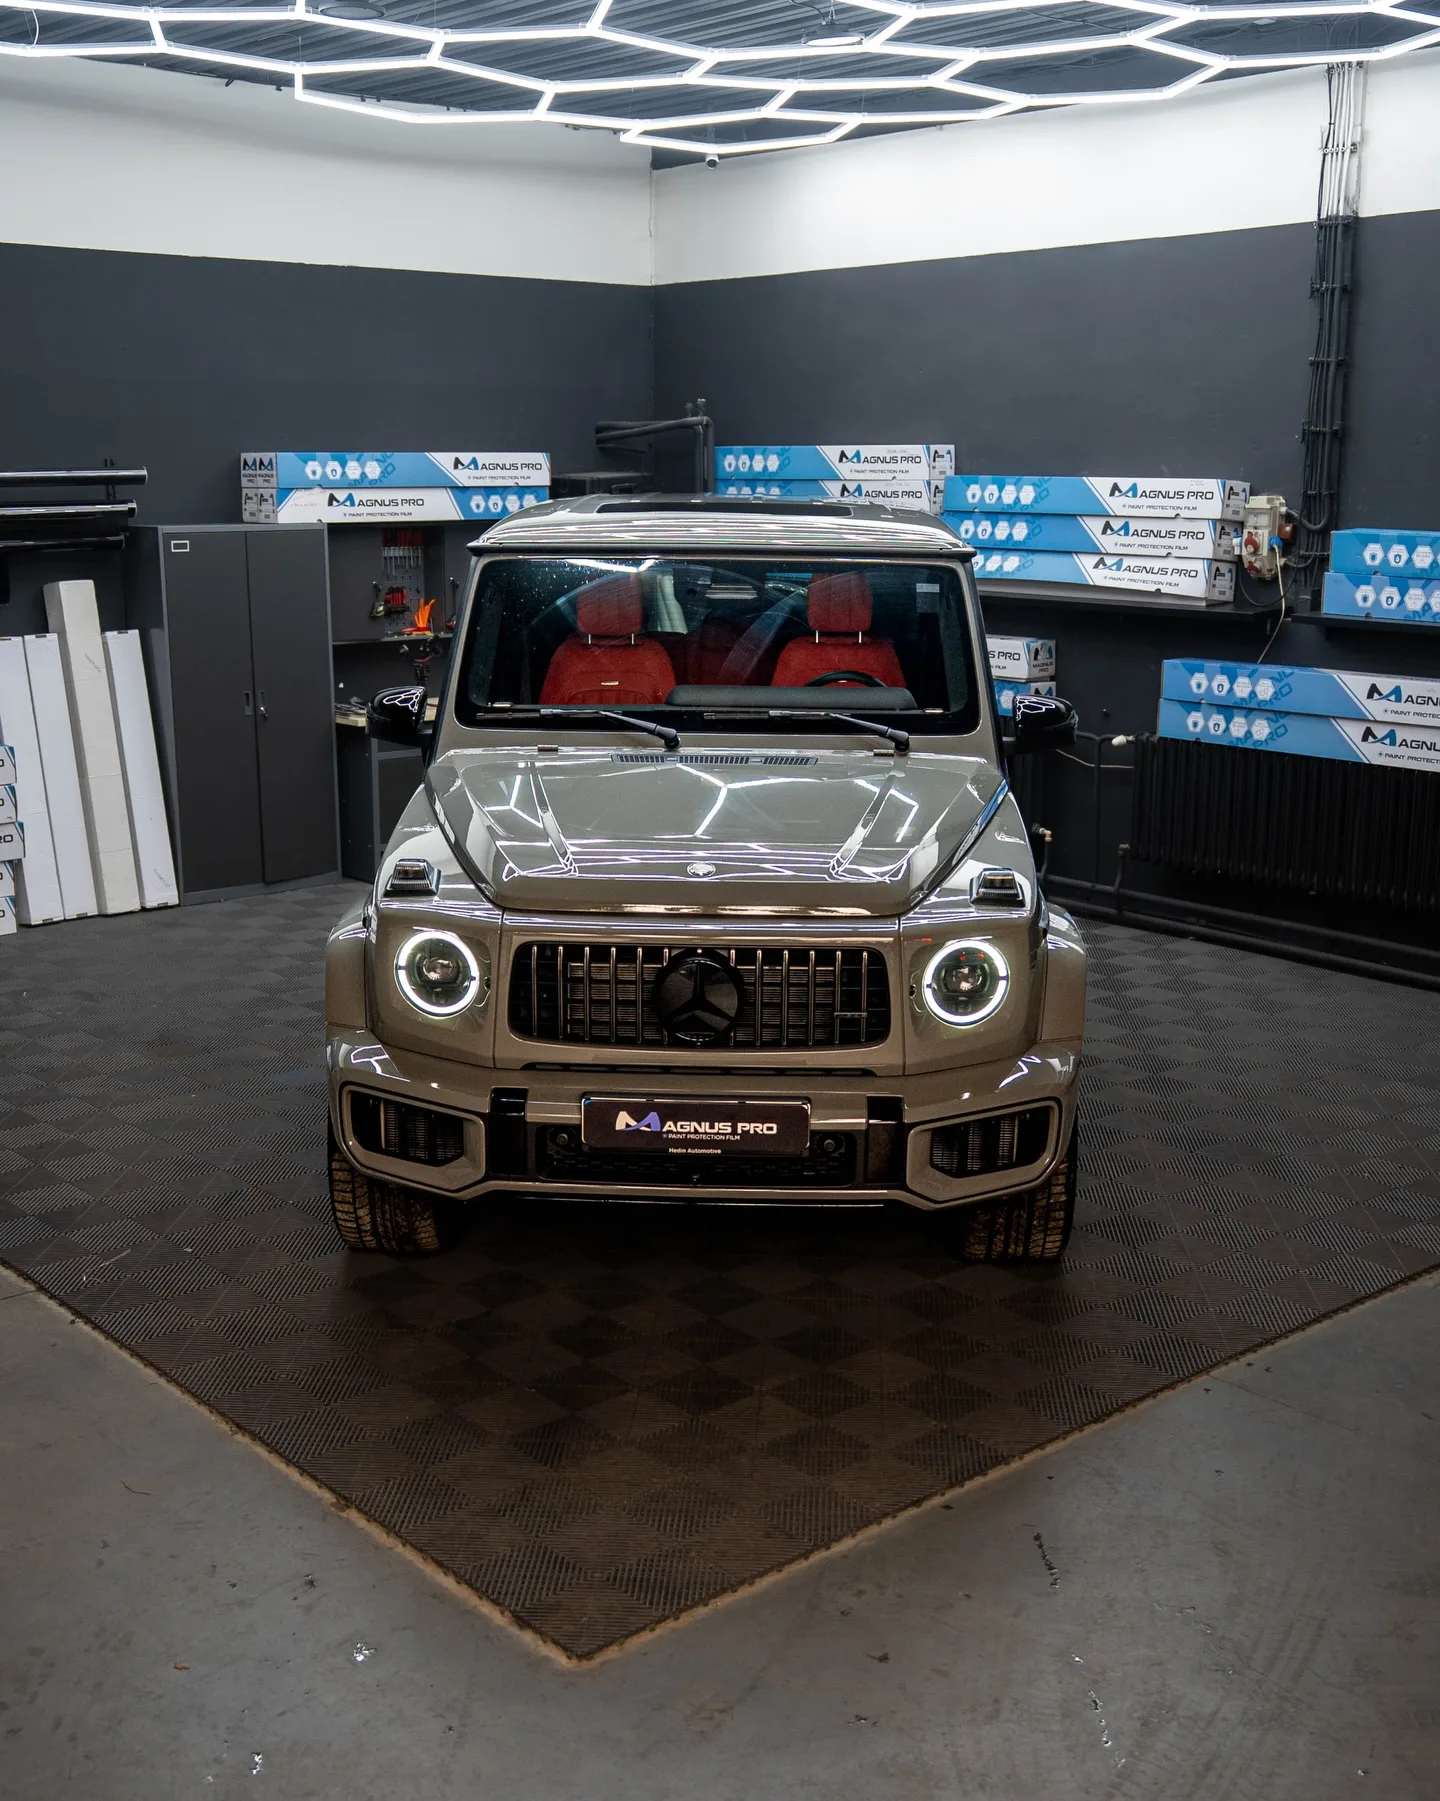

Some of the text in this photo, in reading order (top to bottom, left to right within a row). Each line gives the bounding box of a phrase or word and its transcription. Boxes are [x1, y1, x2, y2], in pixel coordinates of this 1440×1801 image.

[453, 456, 518, 470] MAGNUS
[838, 450, 898, 464] MAGNUS
[900, 456, 922, 464] PRO
[840, 484, 900, 498] MAGNUS
[901, 491, 922, 499] PRO
[1109, 482, 1185, 500] MAGNUS
[1186, 491, 1214, 500] PRO
[328, 492, 399, 507] MAGNUS
[400, 498, 425, 506] PRO
[1101, 520, 1176, 539] MAGNUS
[1178, 531, 1205, 540] PRO
[1092, 556, 1198, 578] MAGNUS PRO
[1126, 578, 1165, 586] PROTECTION
[997, 652, 1020, 661] PRO
[1366, 683, 1440, 707] MAGN
[1384, 752, 1406, 760] PAINT
[616, 1111, 777, 1134] MAGNUS PRO
